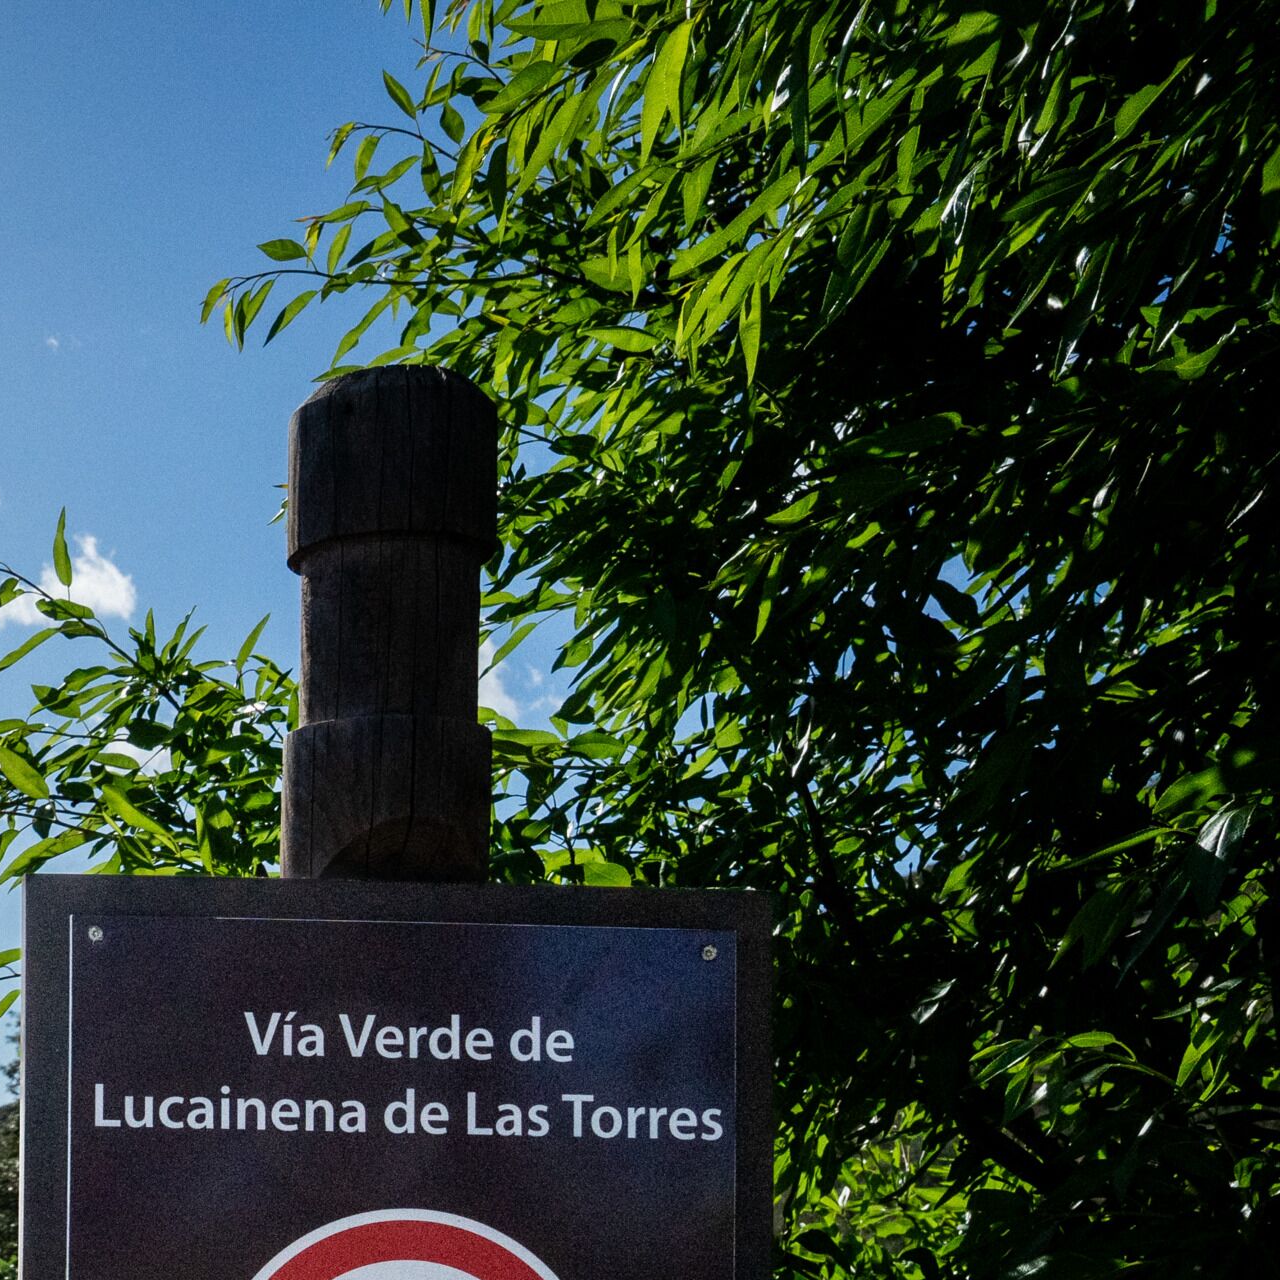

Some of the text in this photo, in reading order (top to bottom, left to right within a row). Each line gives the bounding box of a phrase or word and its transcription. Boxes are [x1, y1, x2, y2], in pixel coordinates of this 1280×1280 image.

[243, 1011, 575, 1063] Vía Verde de
[93, 1083, 724, 1141] Lucainena de Las Torres
